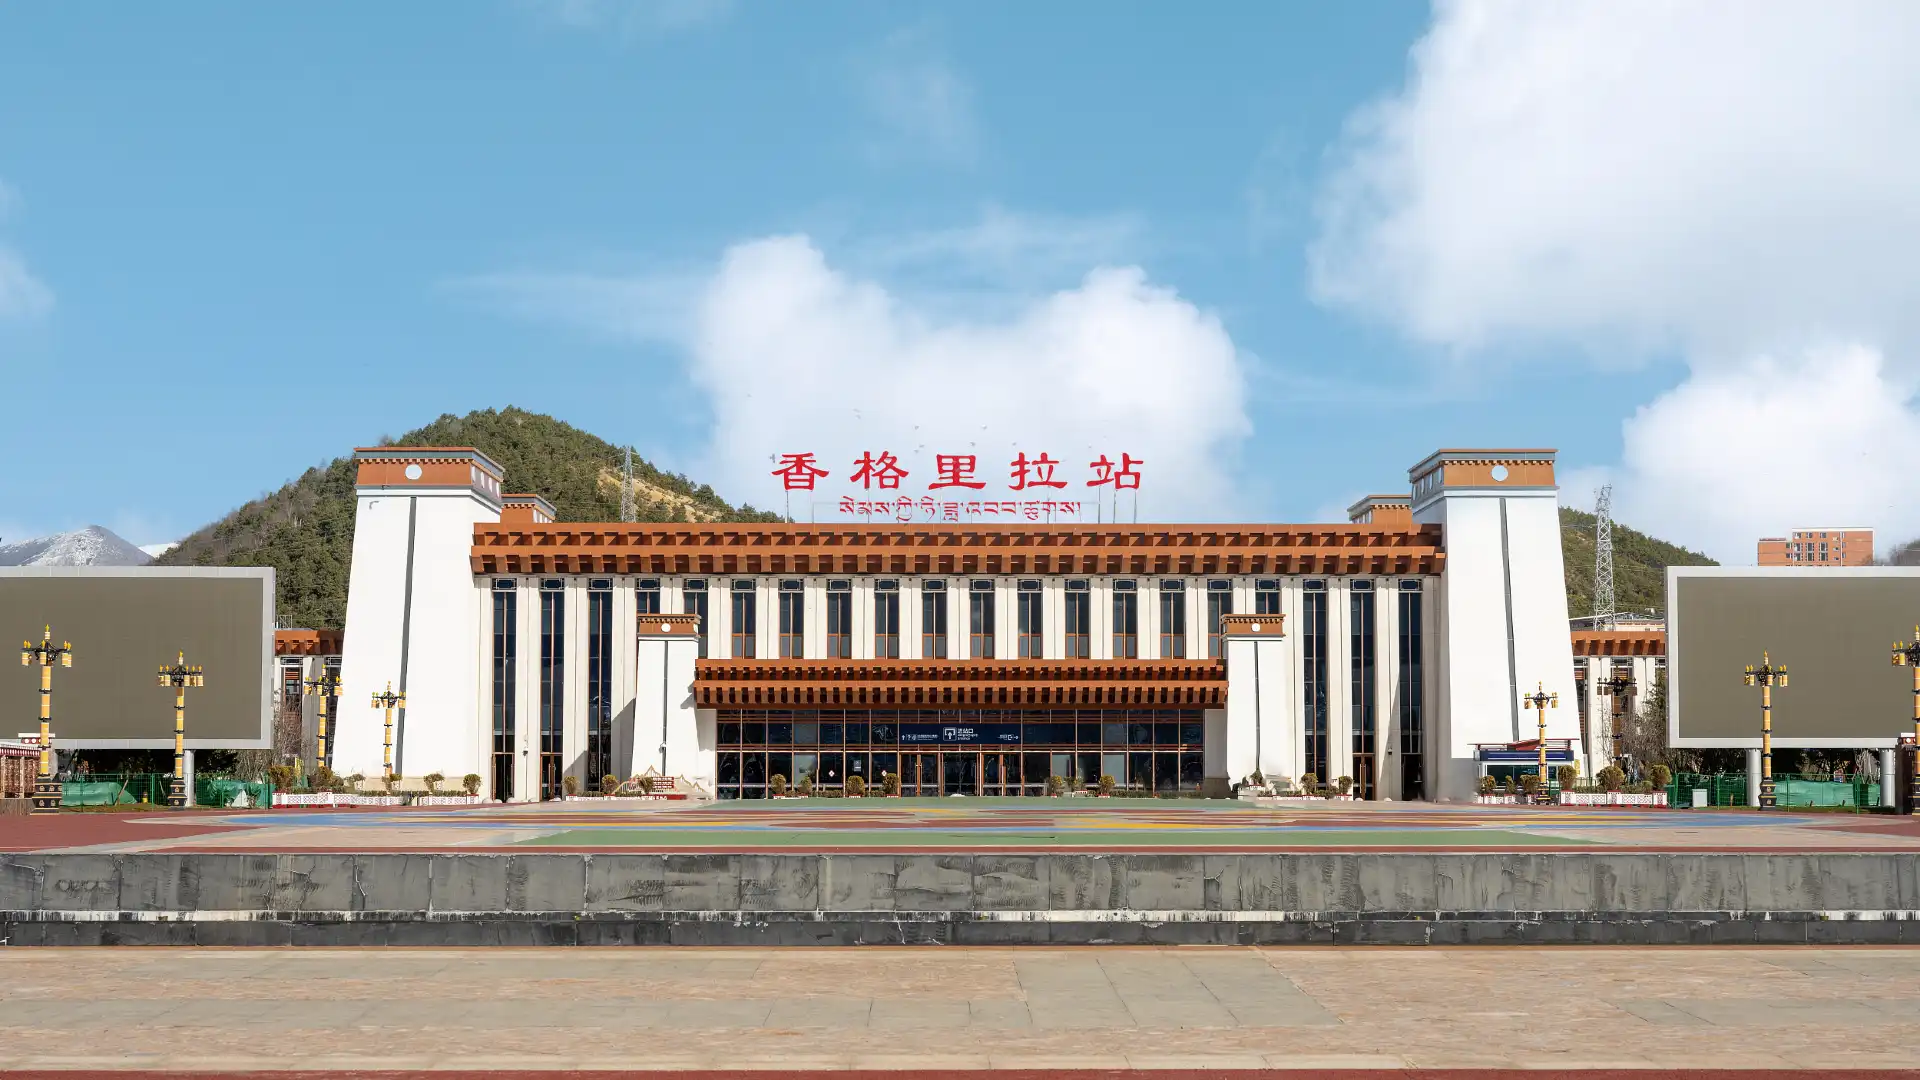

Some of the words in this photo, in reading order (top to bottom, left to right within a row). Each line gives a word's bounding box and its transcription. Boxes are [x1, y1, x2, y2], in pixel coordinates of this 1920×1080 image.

[771, 450, 1145, 491] 香格里拉站
